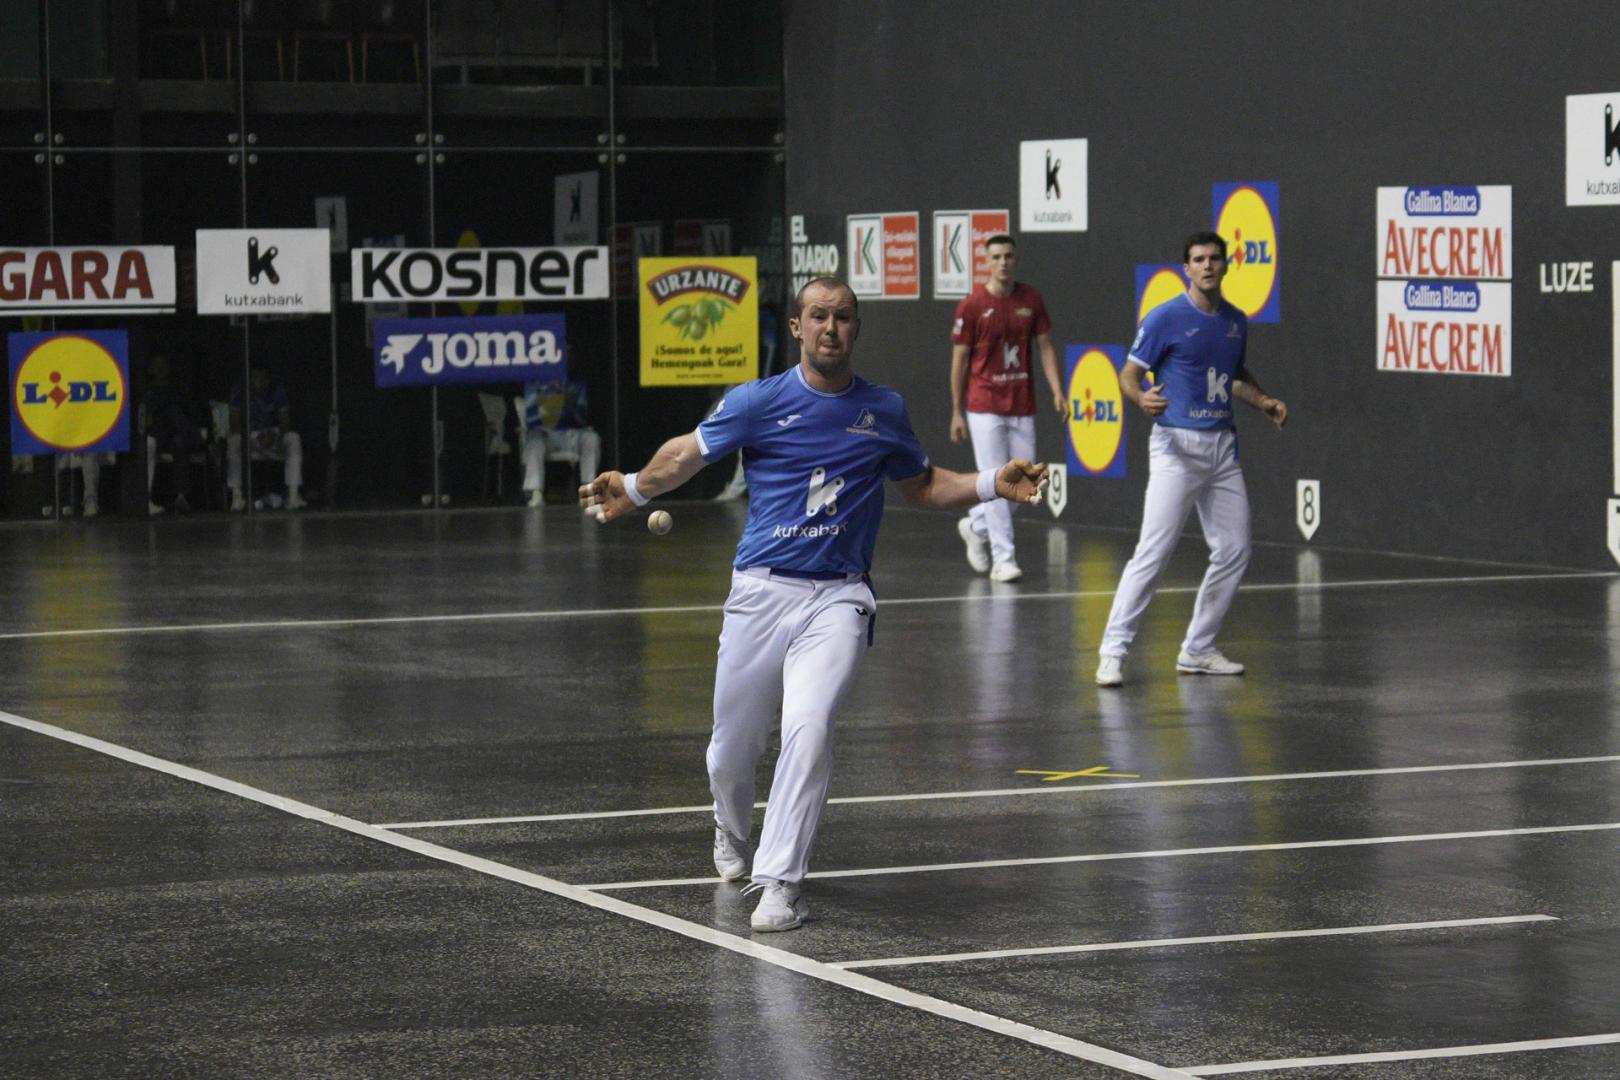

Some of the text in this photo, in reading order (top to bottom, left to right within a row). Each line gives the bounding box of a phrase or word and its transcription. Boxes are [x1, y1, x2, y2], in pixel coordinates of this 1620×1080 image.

[1407, 190, 1477, 213] Gallina Blanca
[791, 215, 808, 243] EL
[792, 244, 839, 273] DIARIO
[1382, 218, 1504, 278] AVECREM
[0, 249, 154, 301] GARA
[654, 270, 742, 298] URZANTE
[1539, 262, 1594, 293] LUZE
[224, 293, 304, 307] kutxabank
[1407, 285, 1477, 309] Gallina Blanca
[699, 344, 711, 355] de
[1382, 312, 1504, 374] AVECREM
[1052, 469, 1063, 505] 9
[1303, 486, 1315, 526] 8
